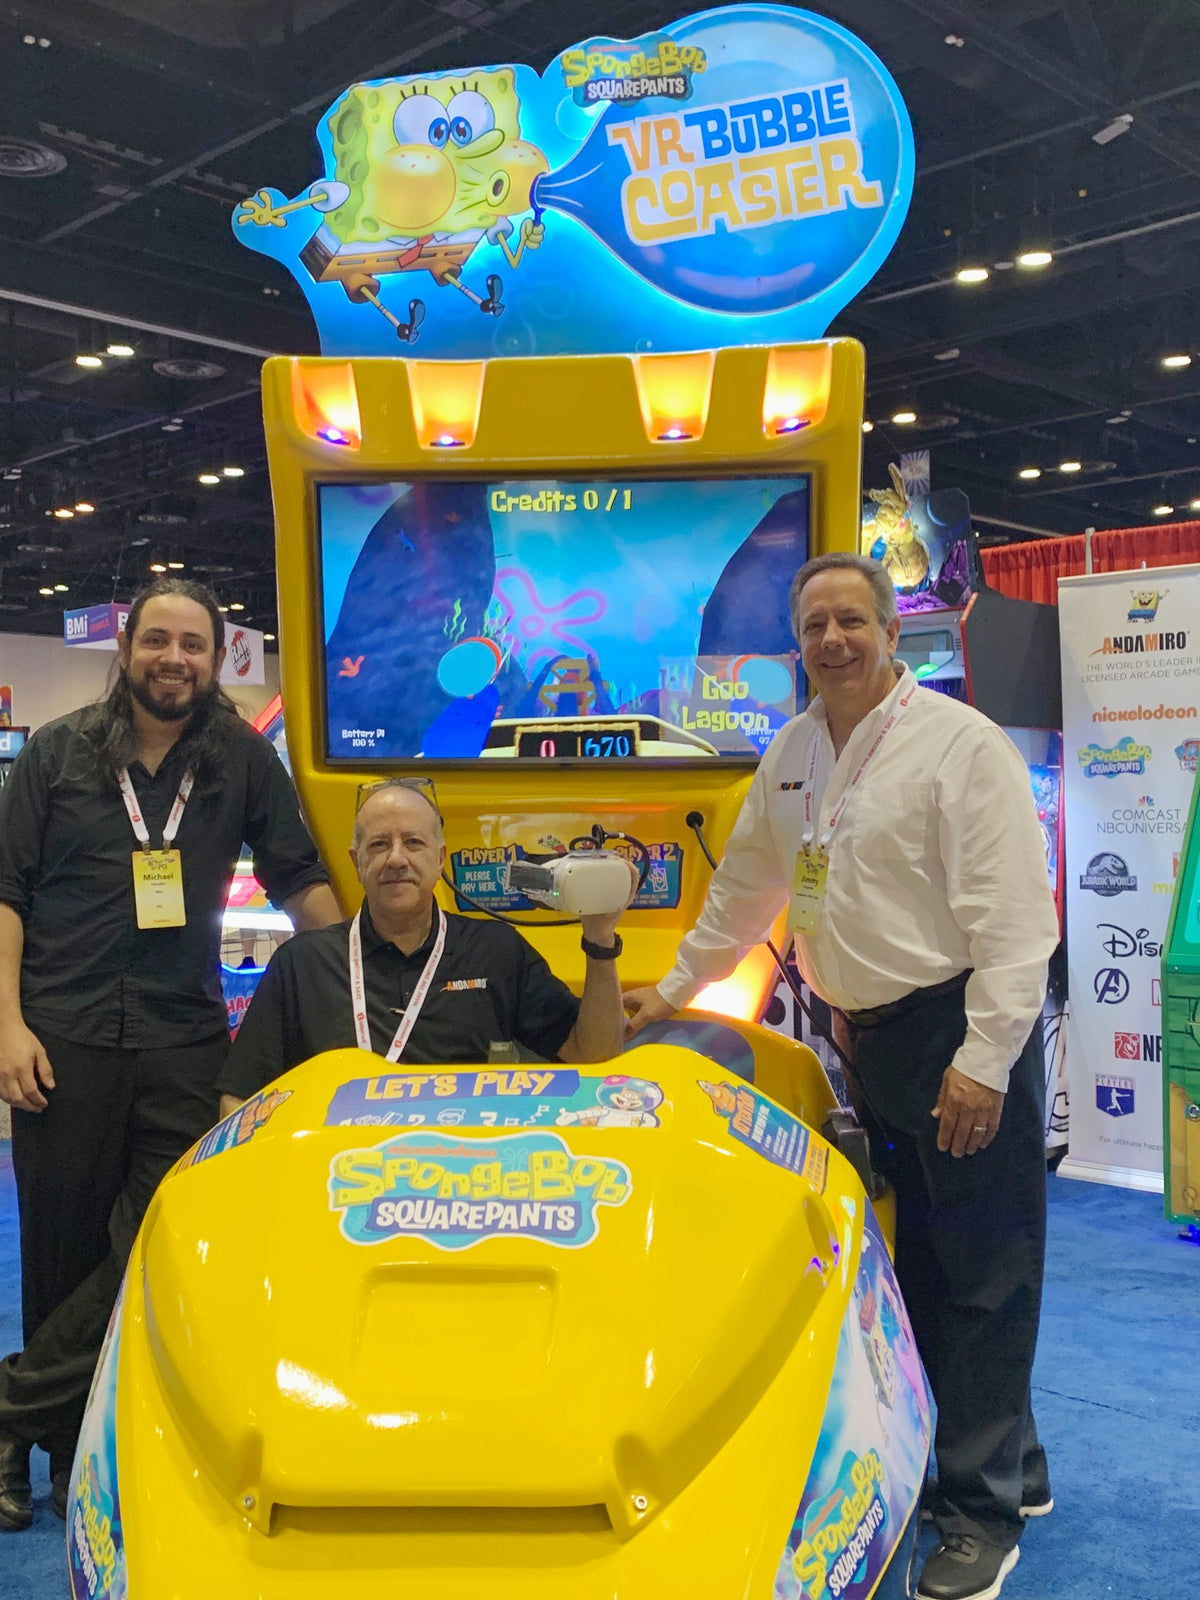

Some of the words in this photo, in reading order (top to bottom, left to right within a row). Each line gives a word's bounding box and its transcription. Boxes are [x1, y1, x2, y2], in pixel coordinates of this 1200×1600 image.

[561, 41, 708, 88] SpongeBob
[587, 76, 686, 99] SQUAREPANTS
[611, 117, 695, 173] VR
[683, 83, 852, 160] BUBBLE
[625, 138, 883, 243] COASTER
[491, 490, 578, 513] Credits
[583, 490, 599, 511] 0
[623, 489, 633, 510] 1
[1086, 663, 1103, 672] THE
[1106, 659, 1151, 670] WORLD'S
[1153, 657, 1194, 667] LEADER
[1081, 673, 1127, 683] LICENSED
[1129, 670, 1171, 680] ARCADE
[702, 675, 749, 700] Goo
[682, 706, 770, 732] Lagoon
[1092, 703, 1198, 723] nickelodeon
[341, 729, 375, 739] Battery
[352, 738, 367, 747] 100
[1112, 808, 1182, 821] COMCAST
[461, 847, 507, 865] PLAYER
[507, 844, 517, 863] 1
[663, 843, 677, 861] 2
[143, 872, 174, 881] Michael
[465, 870, 491, 881] PLEASE
[1109, 875, 1136, 887] WORLD
[461, 882, 476, 893] PAY
[478, 881, 497, 892] HERE
[364, 1074, 458, 1100] LET'S
[472, 1070, 555, 1097] PLAY
[386, 1142, 498, 1158] nickelodeon
[332, 1150, 630, 1209] SpongeBob
[375, 1200, 576, 1232] SQUAREPANTS
[829, 1499, 885, 1597] SQUAREPANTS
